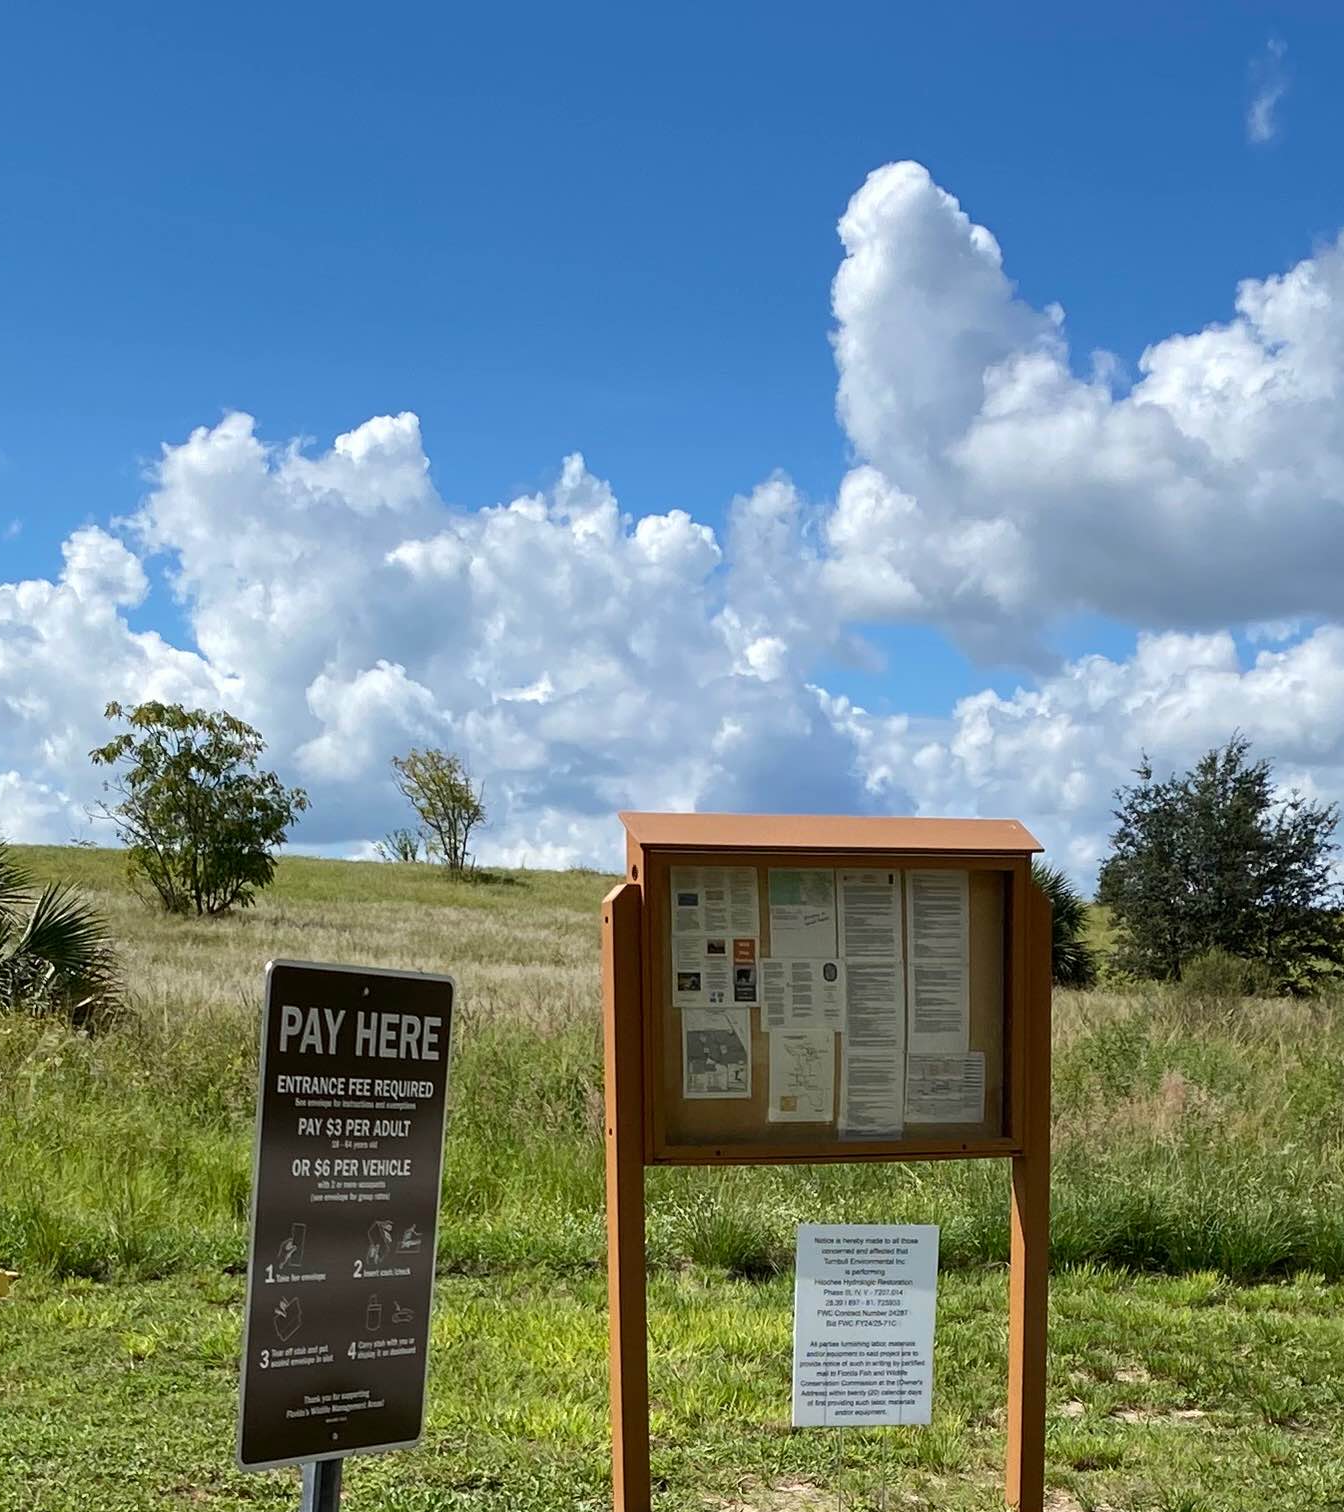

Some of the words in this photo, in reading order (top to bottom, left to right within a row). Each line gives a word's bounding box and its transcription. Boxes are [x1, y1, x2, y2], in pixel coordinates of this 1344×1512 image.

[279, 1006, 346, 1055] PAY
[356, 1011, 442, 1060] HERE
[277, 1075, 345, 1095] ENTRANCE
[349, 1079, 371, 1096] FEE
[375, 1080, 433, 1099] REQUIRED
[298, 1118, 323, 1136] PAY
[326, 1118, 342, 1137] $3
[347, 1119, 370, 1136] PER
[374, 1119, 411, 1137] ADULT
[292, 1159, 310, 1176] OR
[314, 1158, 330, 1177] $6
[334, 1159, 358, 1176] PER
[362, 1160, 411, 1176] VEHICLE
[265, 1264, 275, 1283] 1
[353, 1260, 363, 1278] 2
[260, 1350, 270, 1369] 3
[347, 1342, 357, 1360] 4
